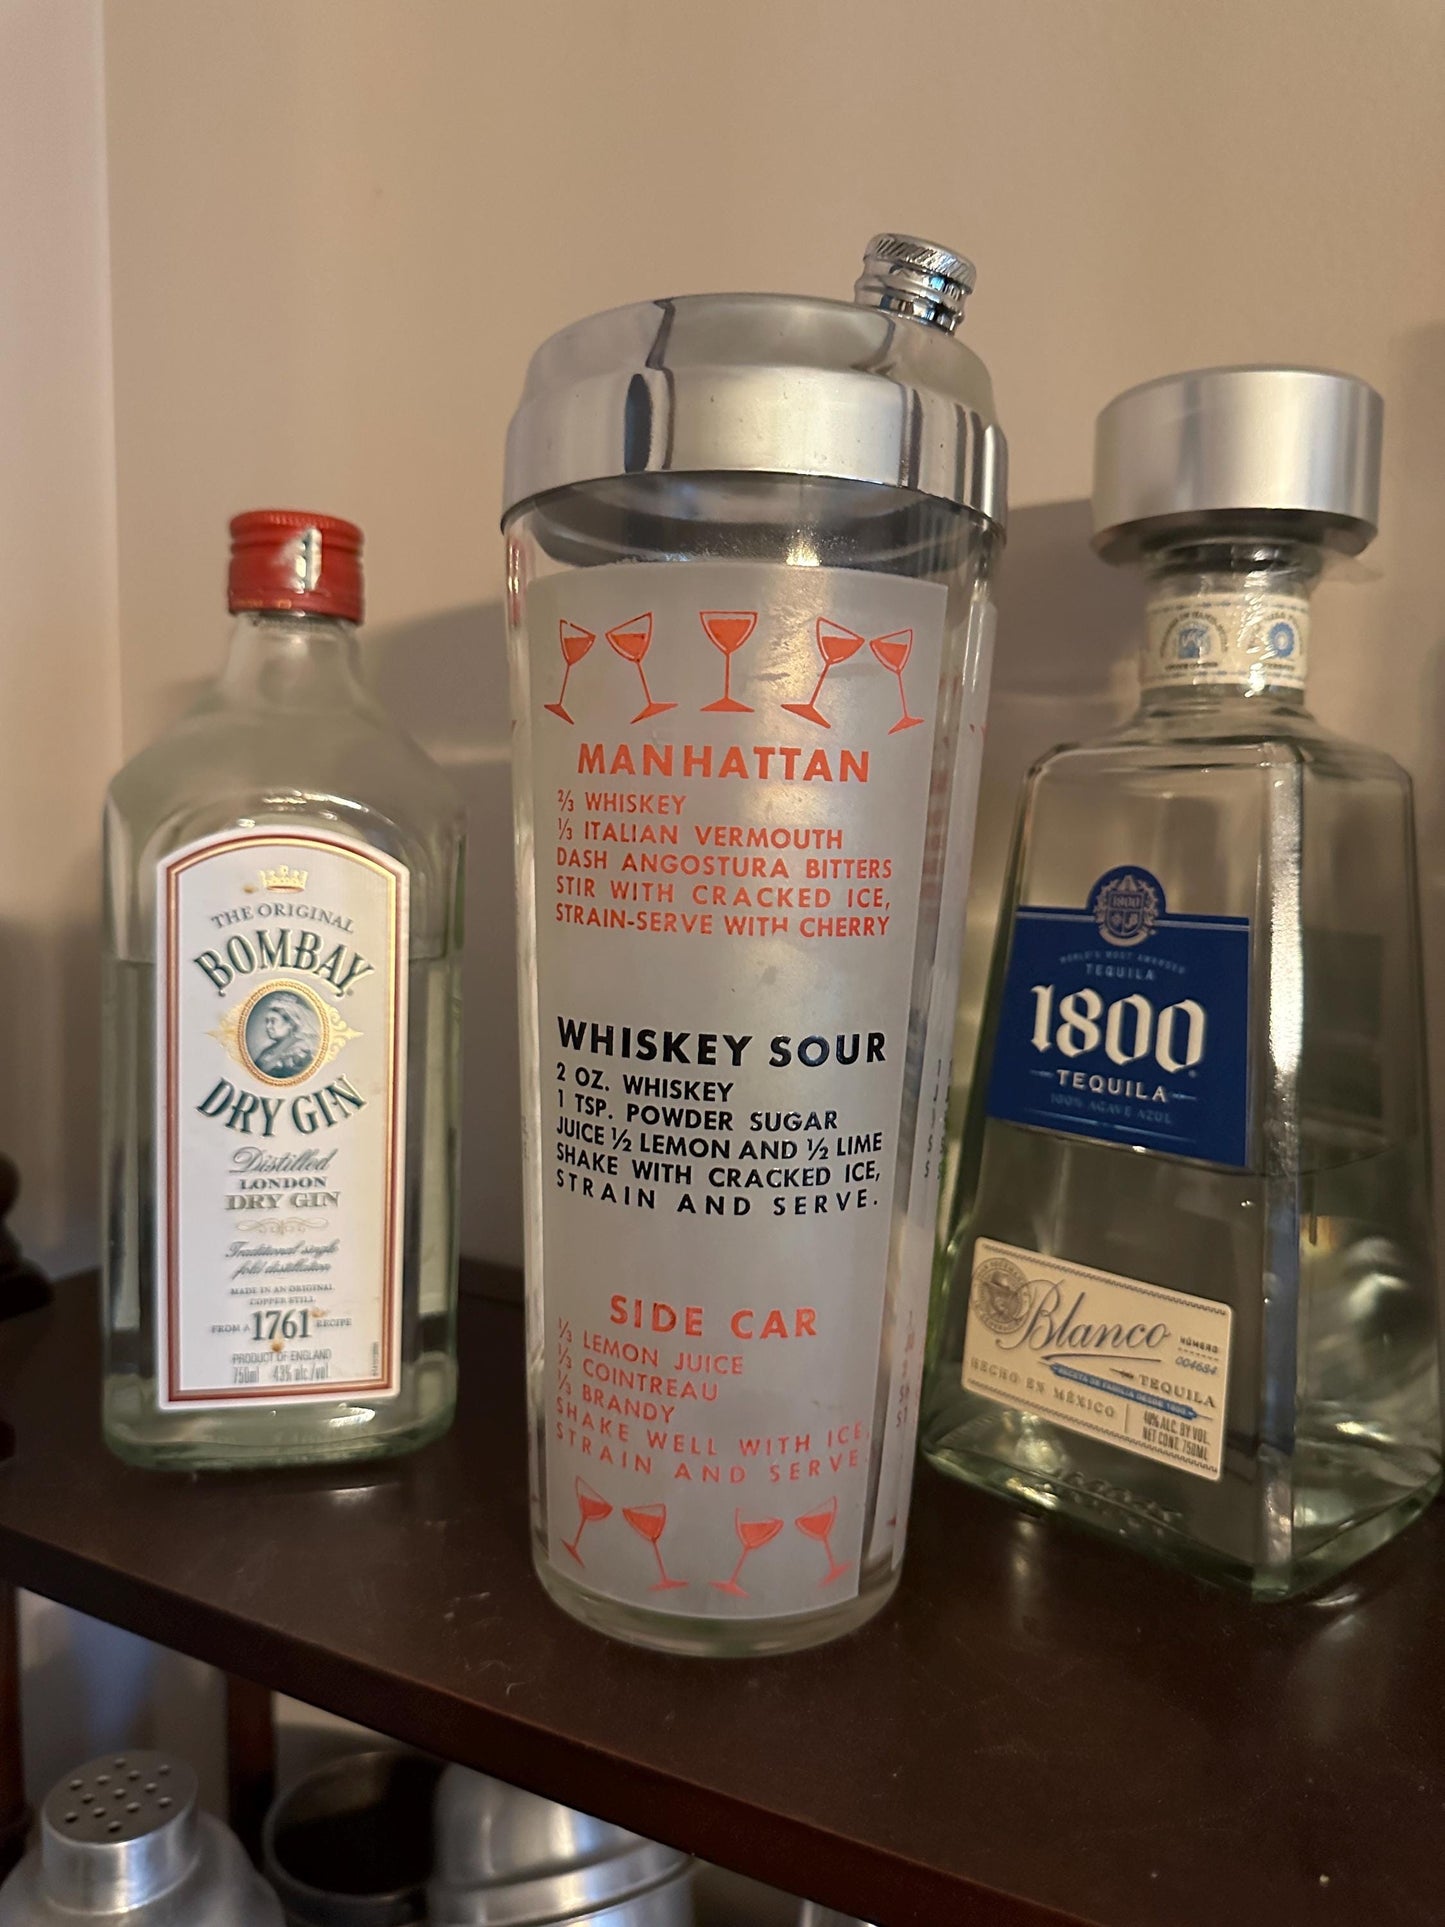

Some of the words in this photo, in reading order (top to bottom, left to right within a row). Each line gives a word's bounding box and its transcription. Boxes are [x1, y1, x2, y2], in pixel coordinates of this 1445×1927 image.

[577, 743, 869, 783] MANHATTAN
[585, 791, 687, 815] WHISKEY
[584, 821, 678, 845] ITALIAN
[694, 825, 843, 850] VERMOUTH
[556, 847, 607, 870] DASH
[621, 853, 789, 879] ANGOSTURA
[806, 858, 892, 879] BITTERS
[556, 876, 595, 898] STIR
[610, 880, 674, 903] WITH
[692, 885, 831, 909] CRACKED
[848, 888, 891, 911] ICE,
[211, 906, 254, 929] THE
[258, 903, 354, 933] ORIGINAL
[556, 903, 713, 936] STRAIN-SERVE
[724, 915, 788, 937] WITH
[800, 916, 890, 938] CHERRY
[194, 928, 375, 996] BOMBAY
[1086, 963, 1154, 980] TEQUILA
[557, 1016, 753, 1067] WHISKEY
[768, 1032, 887, 1068] SOUR
[1031, 984, 1207, 1073] 1800
[556, 1062, 566, 1081] 2
[575, 1067, 610, 1092] OZ.
[623, 1074, 734, 1103] WHISKEY
[1056, 1069, 1166, 1103] TEQUILA
[197, 1077, 283, 1137] DRY
[292, 1074, 367, 1135] GIN
[557, 1089, 564, 1107] 1
[575, 1094, 613, 1120] TSP.
[627, 1103, 734, 1131] POWDER
[750, 1111, 838, 1132] SUGAR
[556, 1116, 605, 1146] JUICE
[640, 1132, 730, 1160] LEMON
[738, 1140, 798, 1161] AND
[837, 1132, 883, 1157] LIME
[229, 1146, 338, 1174] Distilled
[556, 1142, 618, 1175] SHAKE
[632, 1160, 692, 1185] WITH
[708, 1166, 831, 1189] CRACKED
[844, 1160, 881, 1183] ICE,
[224, 1194, 282, 1210] DRY
[290, 1191, 341, 1208] GIN
[240, 1176, 328, 1189] LONDON
[556, 1170, 656, 1210] STRAIN
[677, 1194, 751, 1216] AND
[773, 1188, 878, 1216] SERVE.
[231, 1287, 257, 1295] MADE
[288, 1283, 333, 1293] ORIGINAL
[211, 1325, 240, 1333] FROM
[252, 1308, 312, 1341] 1761
[316, 1318, 352, 1328] RECIPE
[610, 1295, 704, 1337] SIDE
[730, 1307, 817, 1339] CAR
[996, 1278, 1172, 1351] Blanco
[232, 1353, 274, 1364] PRODUCT
[276, 1352, 288, 1361] OF
[290, 1349, 332, 1361] ENGLAND
[583, 1330, 659, 1367] LEMON
[674, 1352, 744, 1375] JUICE
[582, 1357, 719, 1401] COINTREAU
[970, 1358, 1021, 1384] HECHO
[1026, 1378, 1045, 1395] EN
[1053, 1387, 1116, 1418] MÉXICO
[1139, 1374, 1217, 1409] TEQUILA
[582, 1383, 676, 1424] BRANDY
[556, 1397, 630, 1442] SHAKE
[647, 1429, 718, 1456] WELL
[739, 1433, 811, 1457] WITH
[556, 1422, 652, 1475] STRAIN
[674, 1462, 746, 1484] AND
